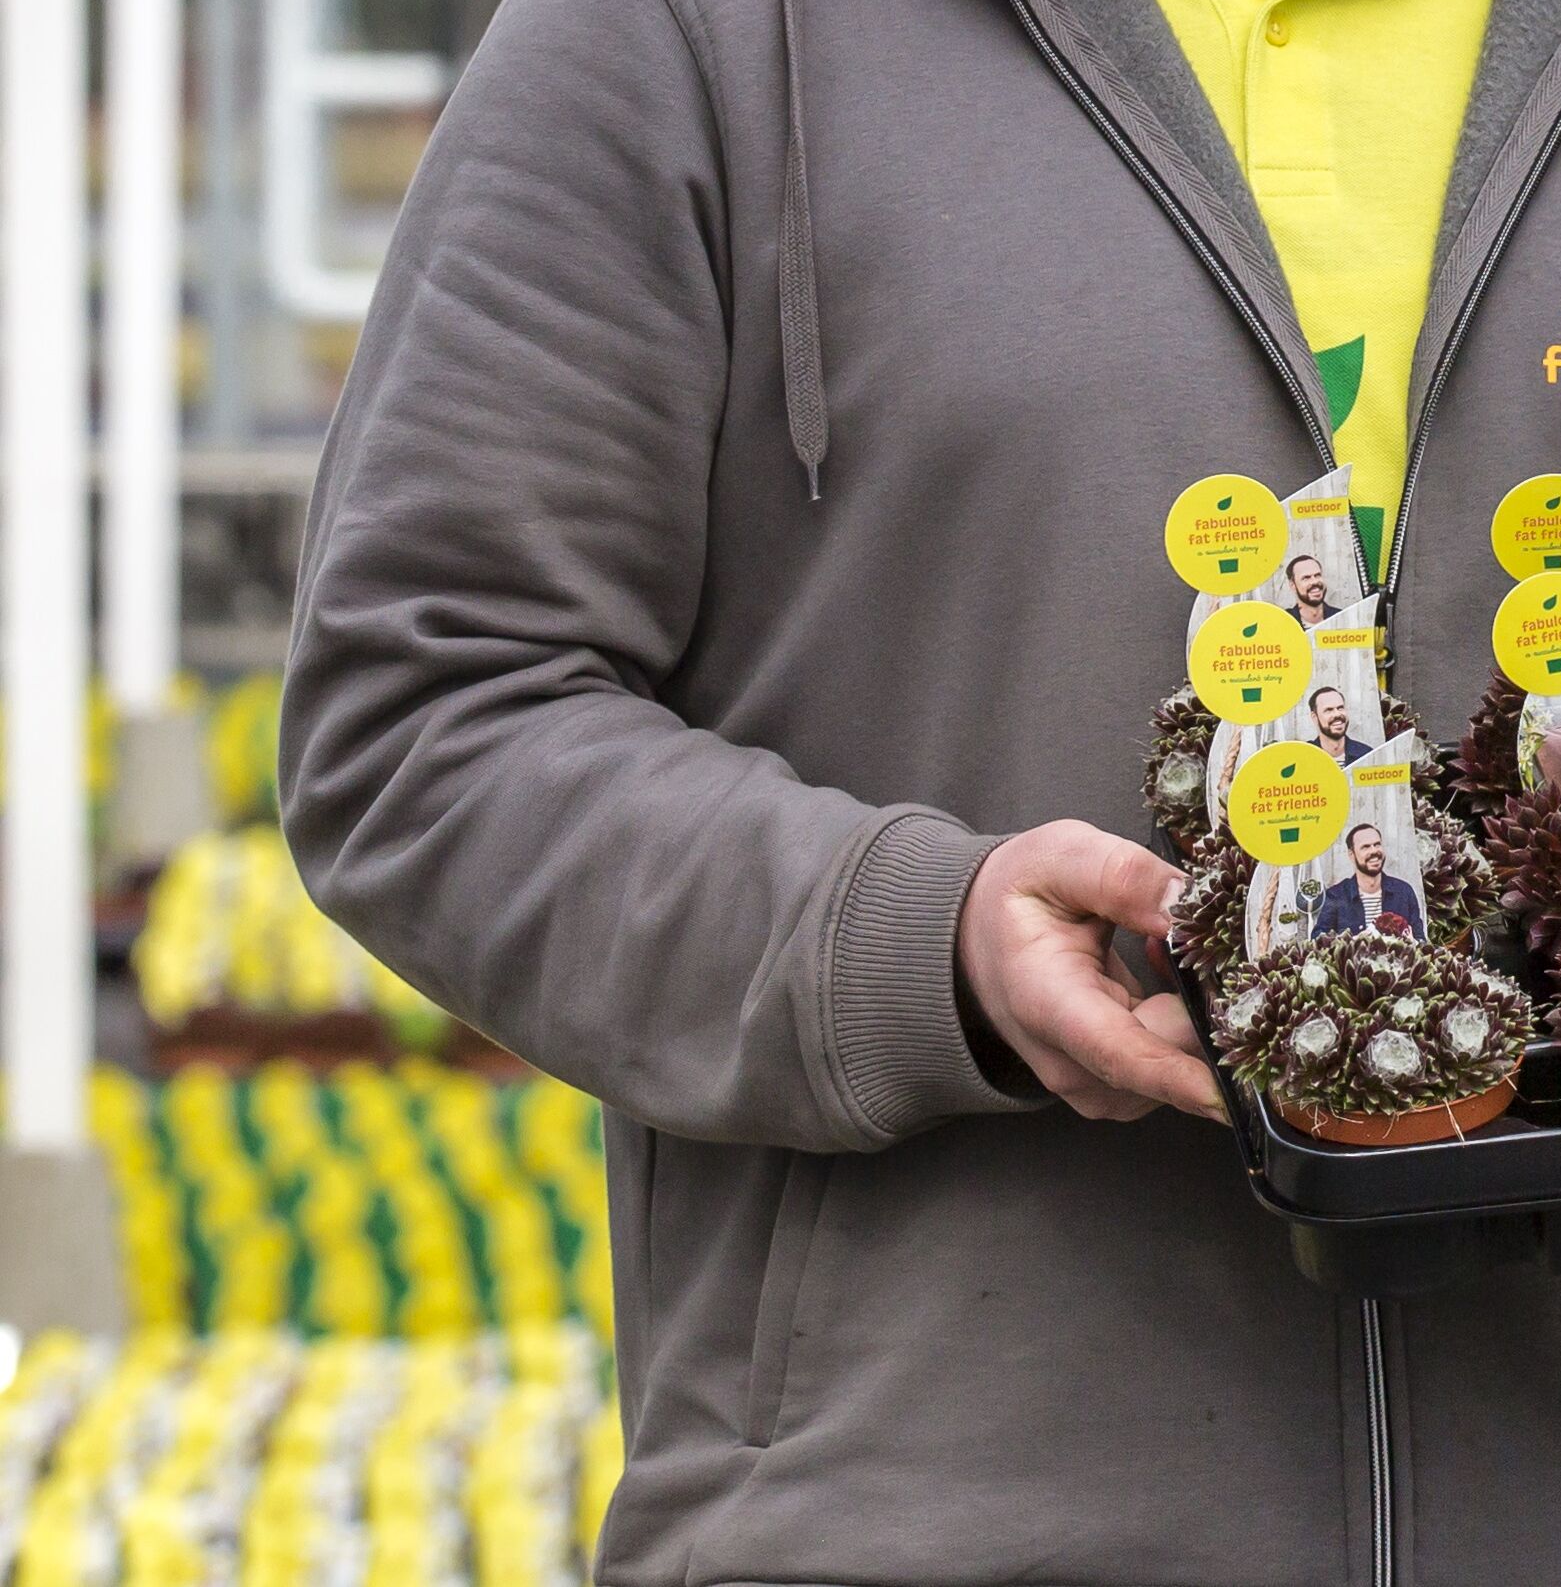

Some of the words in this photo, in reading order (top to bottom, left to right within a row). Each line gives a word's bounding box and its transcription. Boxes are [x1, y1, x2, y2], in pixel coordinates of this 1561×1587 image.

[1297, 502, 1341, 513] outdoor
[1195, 516, 1256, 530] fabulous
[1188, 534, 1210, 545] fat
[1215, 528, 1265, 543] friends
[1515, 531, 1536, 541] fat
[1322, 634, 1366, 644] outdoor
[1516, 636, 1537, 648] fat
[1219, 644, 1281, 656] fabulous
[1213, 661, 1234, 672] fat
[1240, 657, 1289, 670] friends
[1360, 770, 1404, 780] outdoor
[1259, 784, 1319, 798] fabulous
[1252, 802, 1272, 813] fat
[1278, 796, 1327, 810] friends
